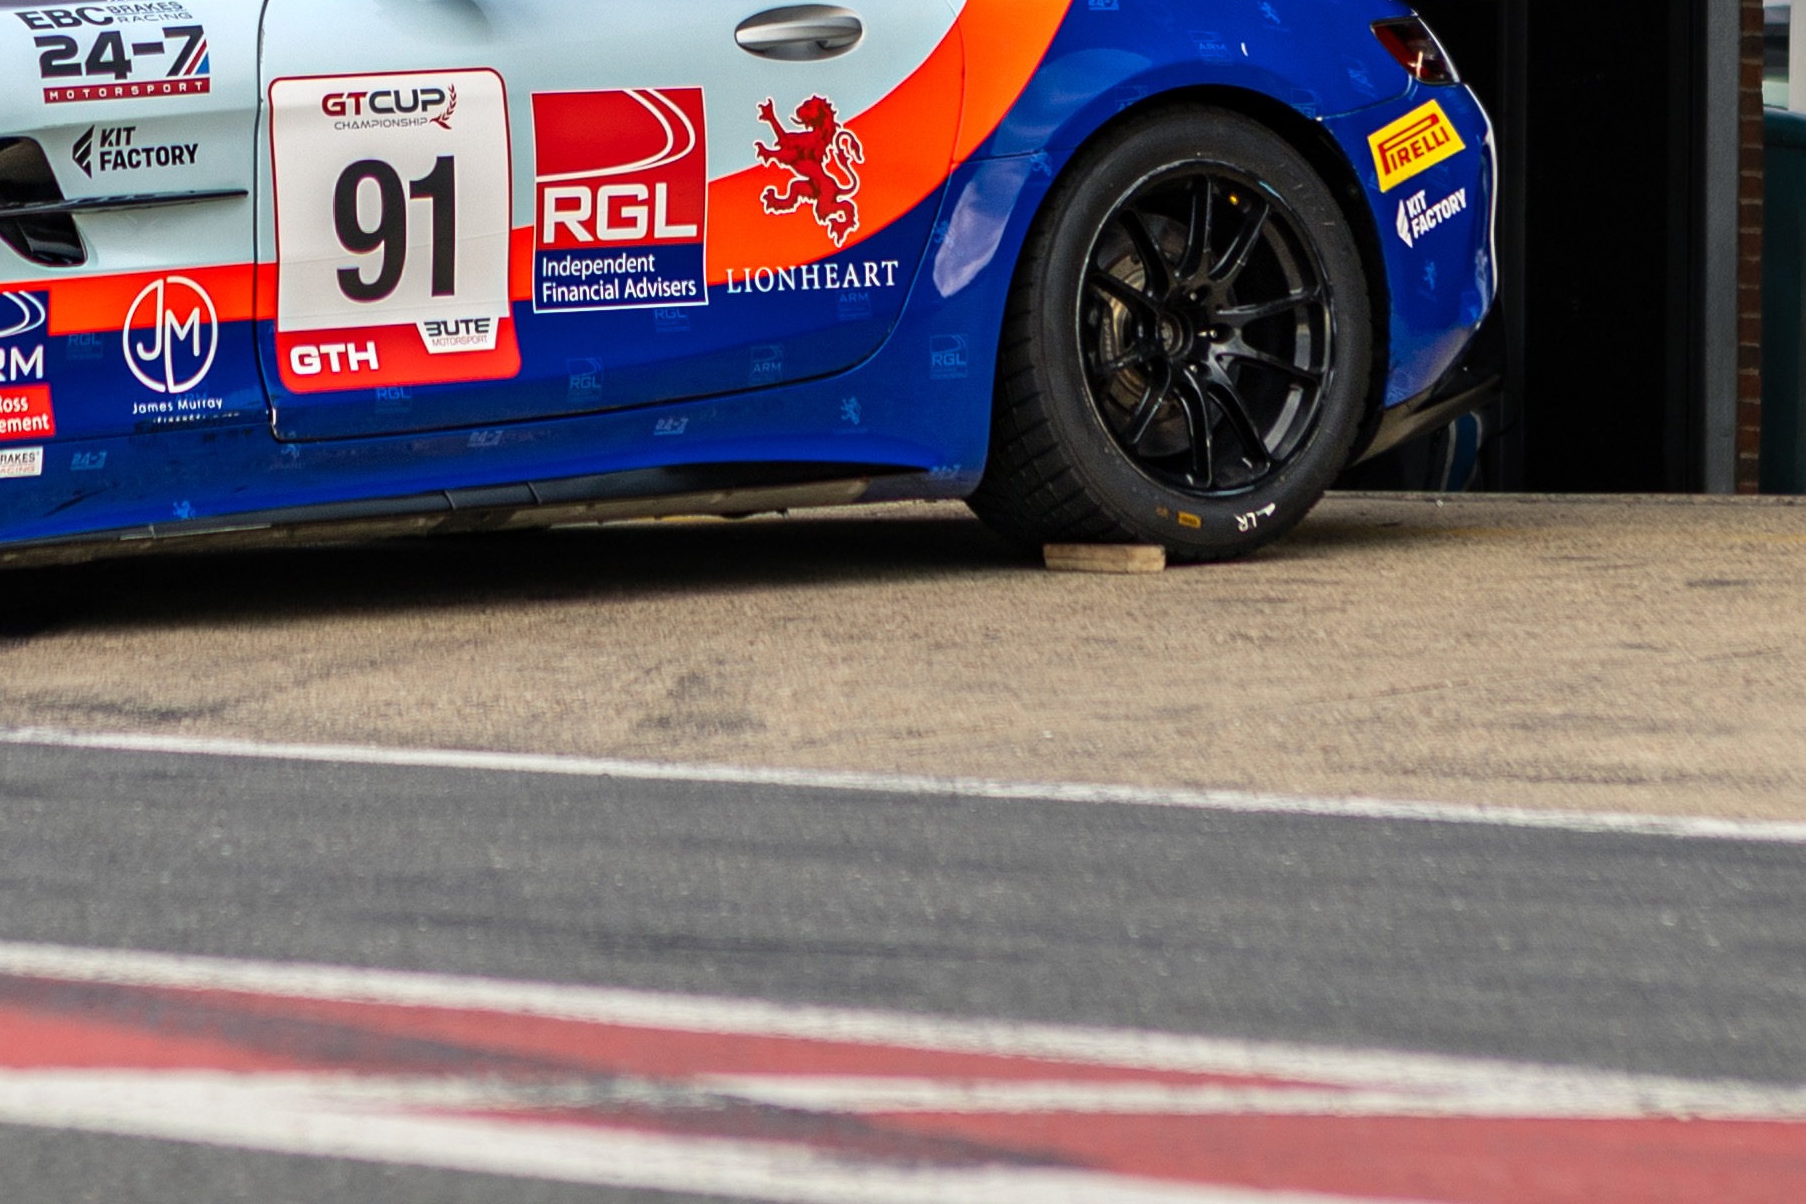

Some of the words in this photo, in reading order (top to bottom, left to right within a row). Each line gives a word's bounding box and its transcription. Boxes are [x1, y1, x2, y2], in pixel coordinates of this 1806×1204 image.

[15, 6, 114, 30] EBC
[106, 1, 185, 14] BRAKES
[117, 12, 193, 24] RACING
[33, 25, 207, 80] 24-7
[49, 81, 203, 101] MOTORSPORT
[100, 126, 136, 148] KIT
[334, 117, 428, 131] CHAMPIONSHIP
[100, 143, 199, 171] FACTORY
[1378, 113, 1450, 176] PIRELLI
[543, 182, 697, 243] RGL
[1406, 189, 1427, 218] KIT
[1411, 187, 1467, 239] FACTORY
[333, 155, 456, 303] 91
[543, 252, 655, 280] Independent
[726, 260, 899, 294] LIONHEART
[543, 278, 619, 303] Financial
[624, 276, 697, 299] Advisers
[432, 335, 488, 347] MOTORSPORT
[290, 341, 380, 374] GTH
[133, 401, 173, 414] James
[178, 397, 223, 410] Murray
